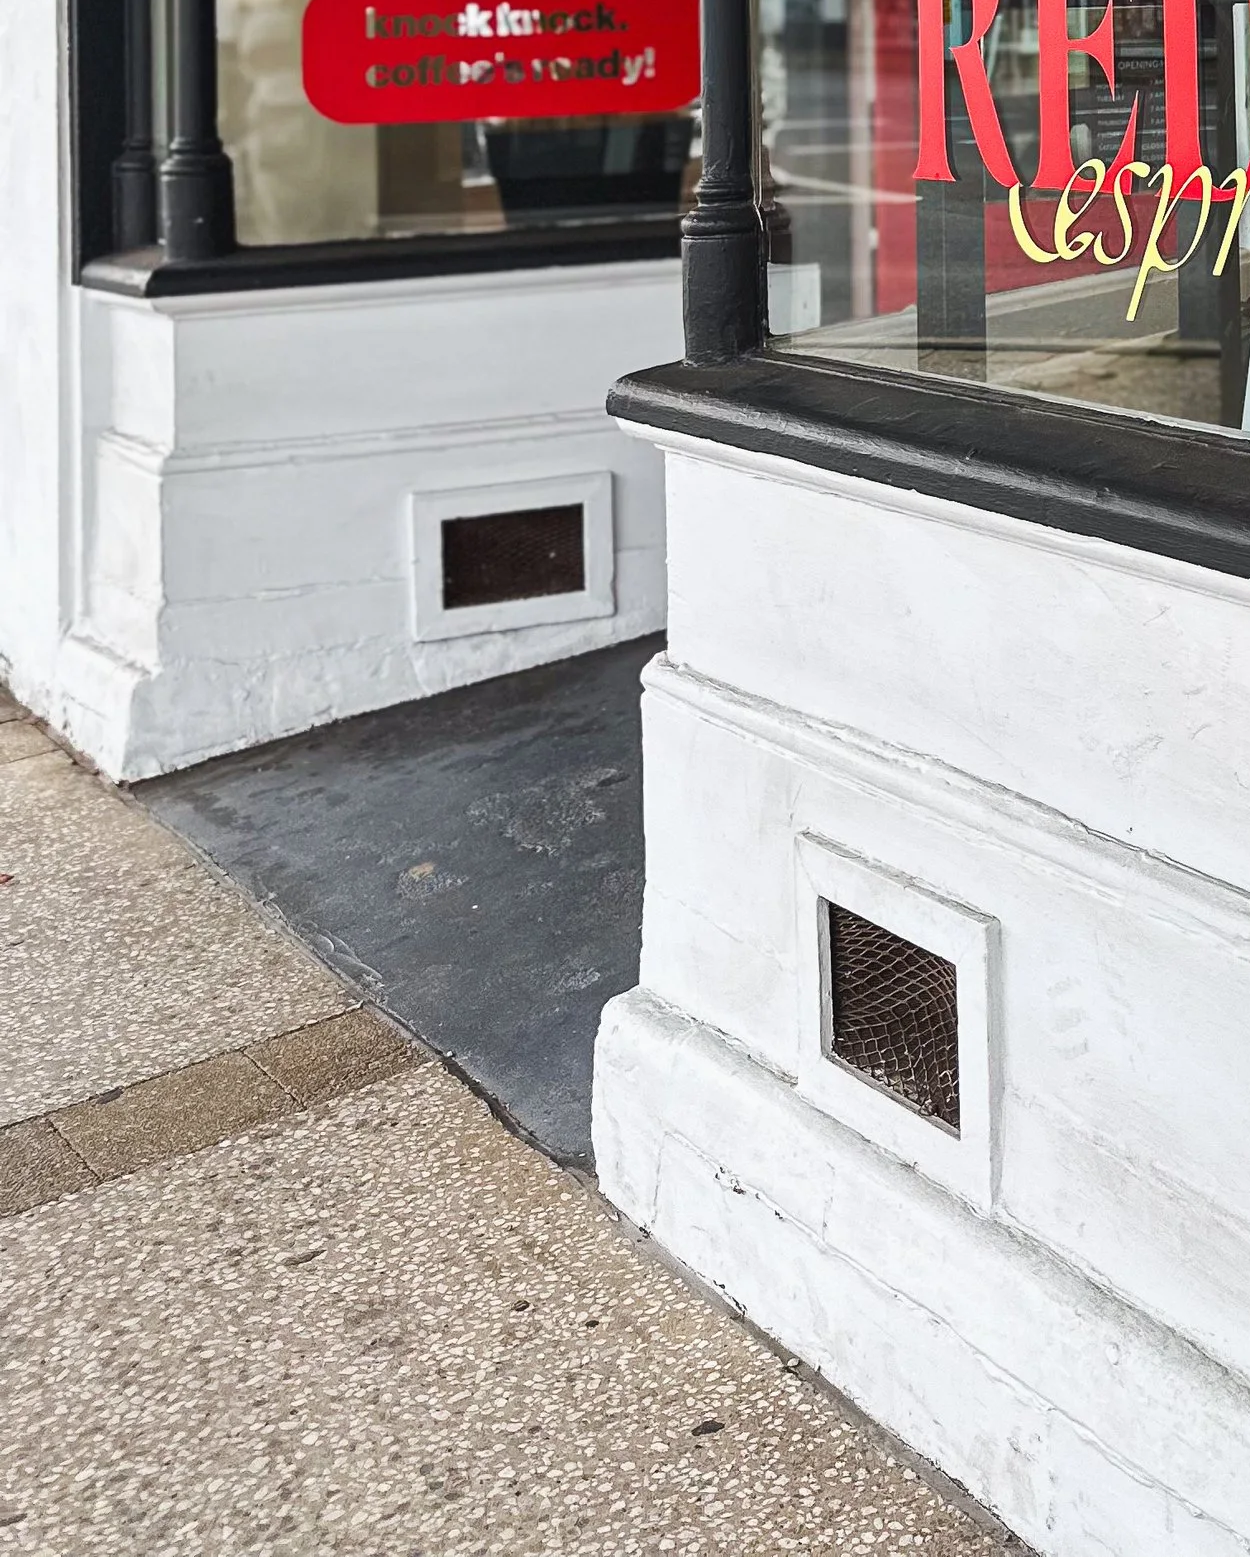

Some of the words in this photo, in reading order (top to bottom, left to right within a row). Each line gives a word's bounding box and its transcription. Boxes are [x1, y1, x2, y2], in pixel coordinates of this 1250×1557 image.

[365, 2, 494, 40] knock
[496, 1, 629, 38] knock.
[365, 51, 525, 89] coffee's
[531, 46, 657, 87] ready!
[1117, 59, 1161, 71] OPENING
